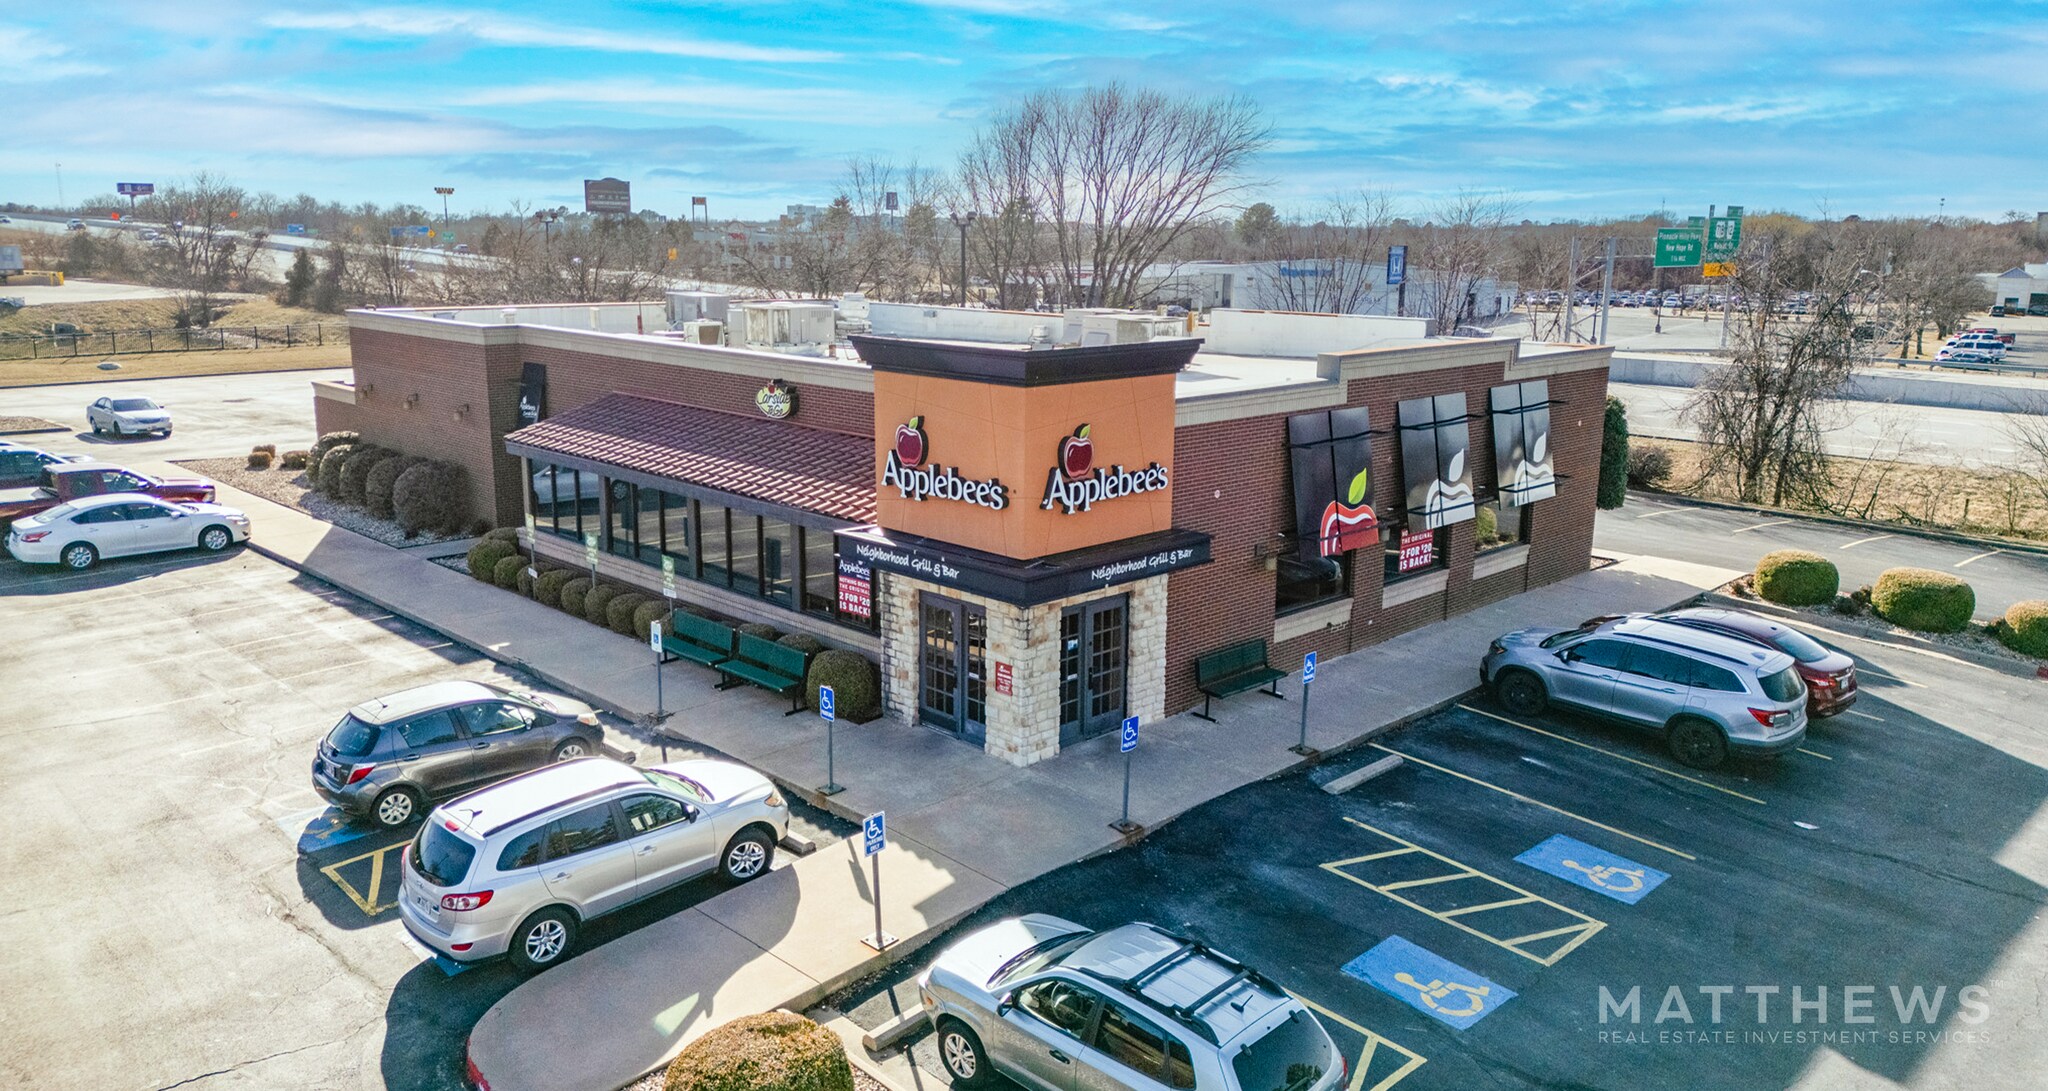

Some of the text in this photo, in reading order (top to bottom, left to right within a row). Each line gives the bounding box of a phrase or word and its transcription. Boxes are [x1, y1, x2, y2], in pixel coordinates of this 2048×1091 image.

[881, 449, 1004, 511] Applebee's
[1043, 462, 1169, 515] Applebee's
[856, 544, 960, 579] Neighborhood Grill & Bar
[1091, 549, 1193, 581] Neighborhood Grill & Bar
[1400, 549, 1405, 560] 2
[1406, 546, 1420, 558] FOR
[1400, 553, 1431, 571] IS BACK!
[839, 591, 844, 600] 2
[844, 593, 858, 604] FOR
[839, 600, 870, 617] IS BACK!
